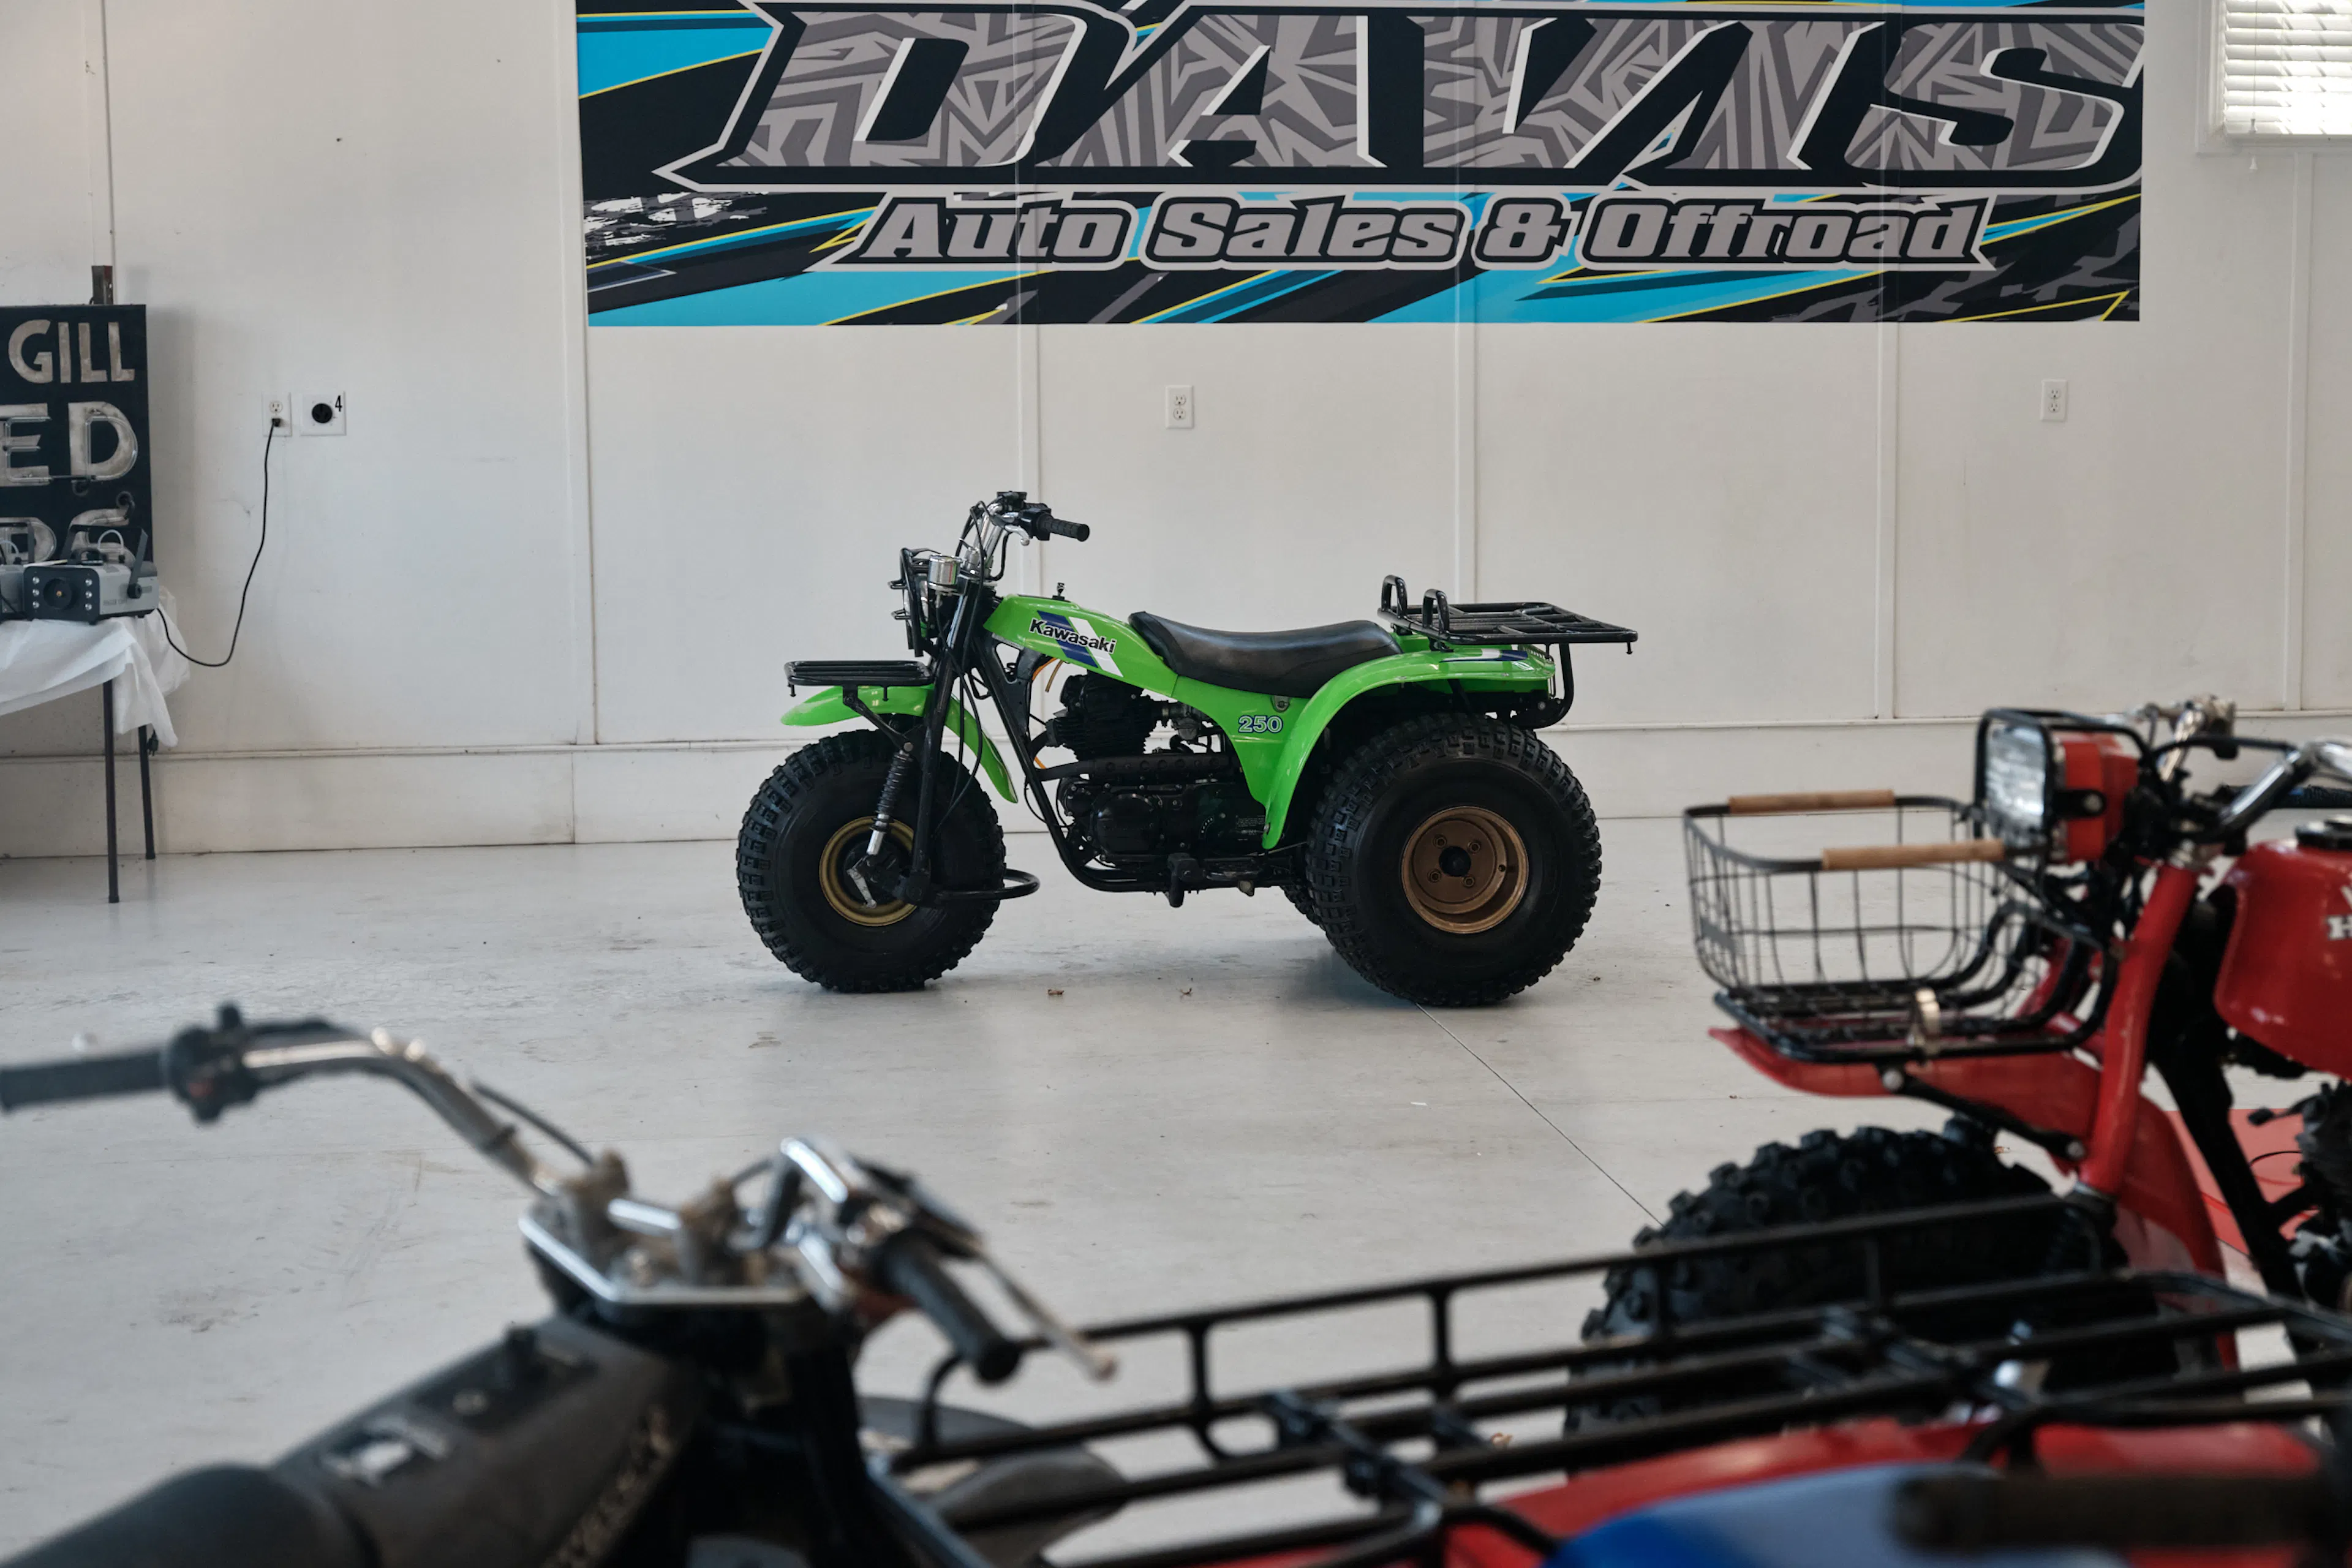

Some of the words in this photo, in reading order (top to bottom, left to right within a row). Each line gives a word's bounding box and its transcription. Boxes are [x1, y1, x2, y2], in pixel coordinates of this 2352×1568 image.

[714, 10, 2145, 172] DAVIS
[858, 199, 1131, 258] Auto
[1153, 202, 1461, 258] Sales
[1480, 203, 1562, 258] &
[1588, 201, 1975, 258] Offroad
[8, 319, 135, 383] GILL
[335, 394, 342, 412] 4
[1029, 617, 1118, 654] Kawasaki
[1238, 714, 1284, 734] 250
